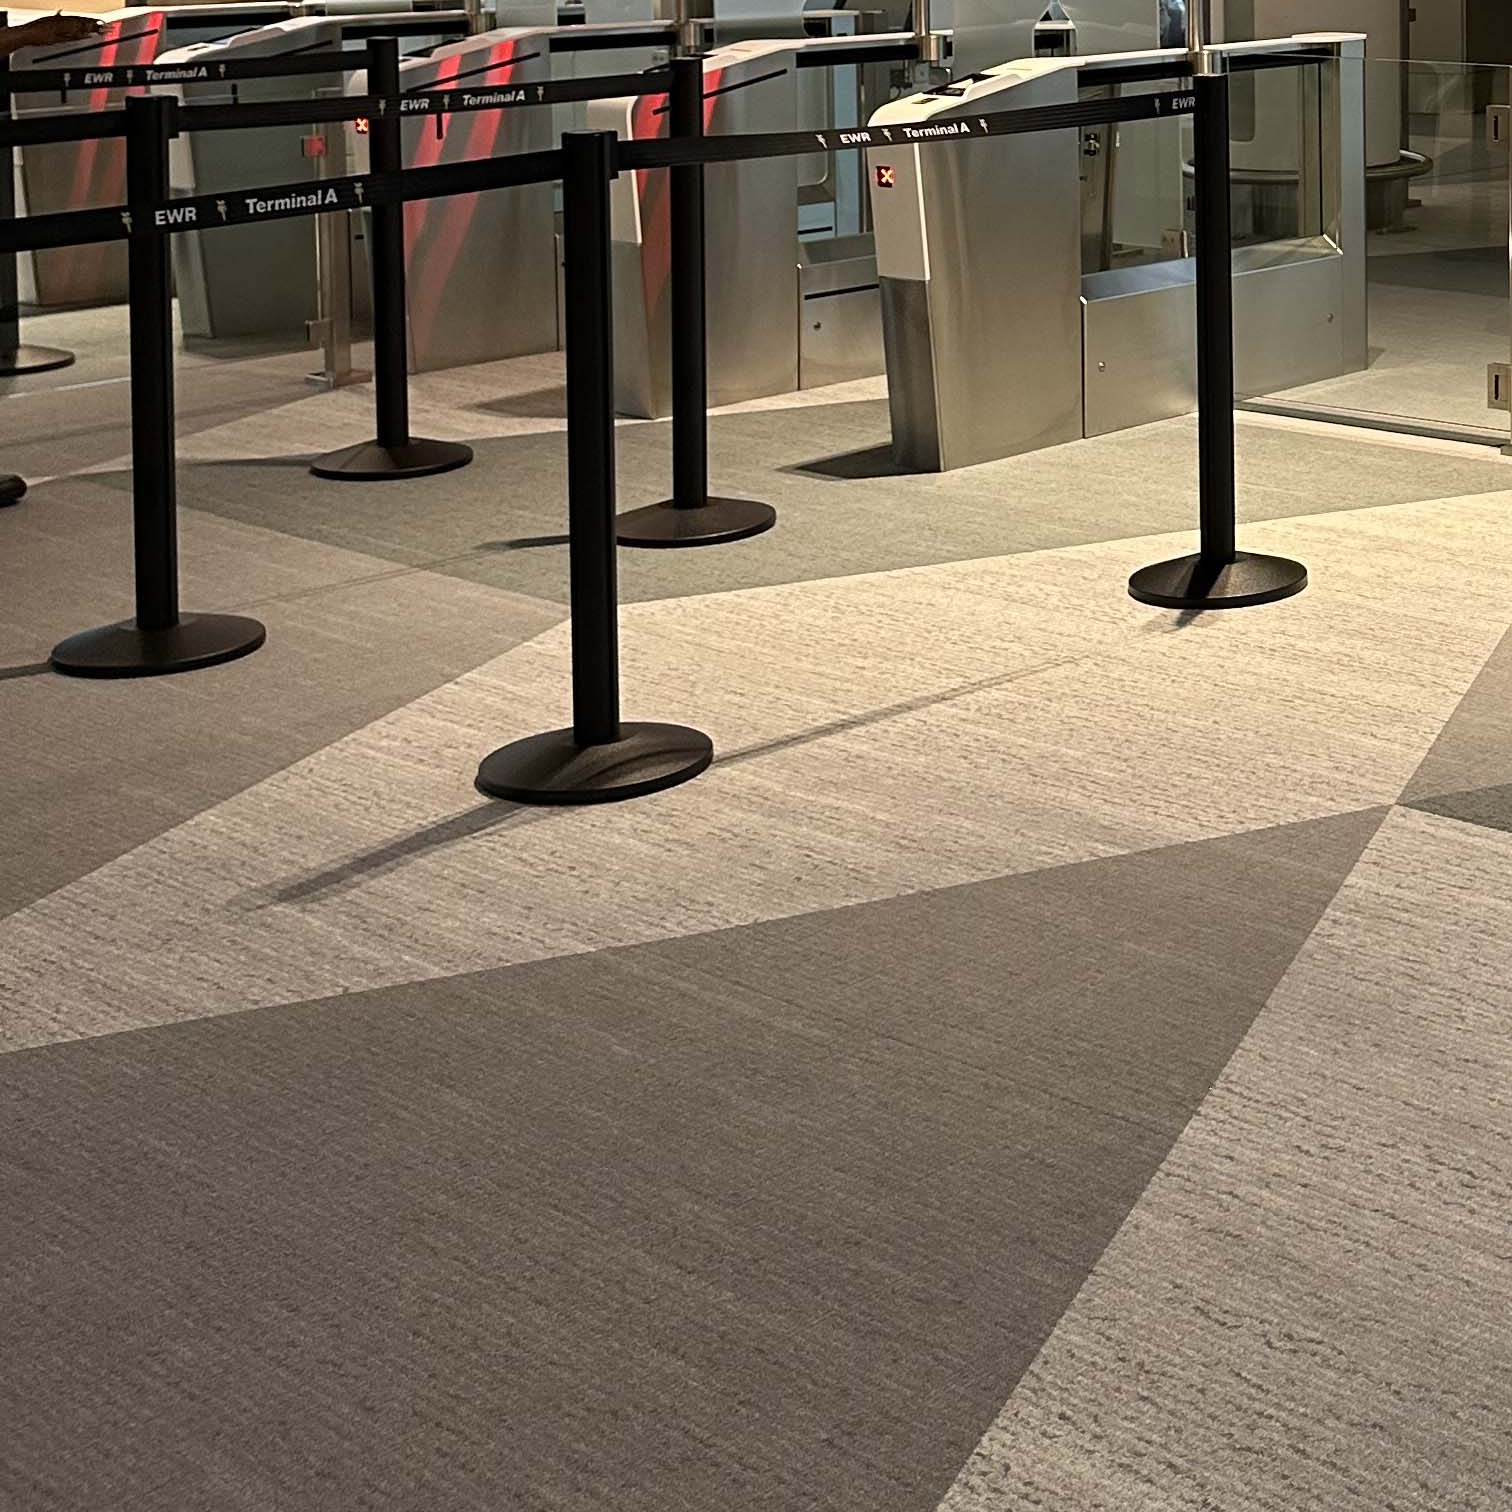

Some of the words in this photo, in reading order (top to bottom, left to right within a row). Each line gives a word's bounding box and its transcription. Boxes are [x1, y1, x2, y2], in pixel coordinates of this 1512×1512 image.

[84, 72, 114, 84] EWR
[145, 68, 197, 81] Terminal
[196, 66, 208, 77] A
[400, 98, 430, 111] EWR
[462, 91, 515, 106] Terminal
[515, 89, 526, 101] A
[1172, 96, 1196, 110] EWR
[839, 132, 872, 144] EWR
[902, 123, 959, 139] Terminal
[960, 121, 971, 134] A
[154, 206, 197, 226] EWR
[245, 189, 322, 214] Terminal
[324, 187, 338, 204] A
